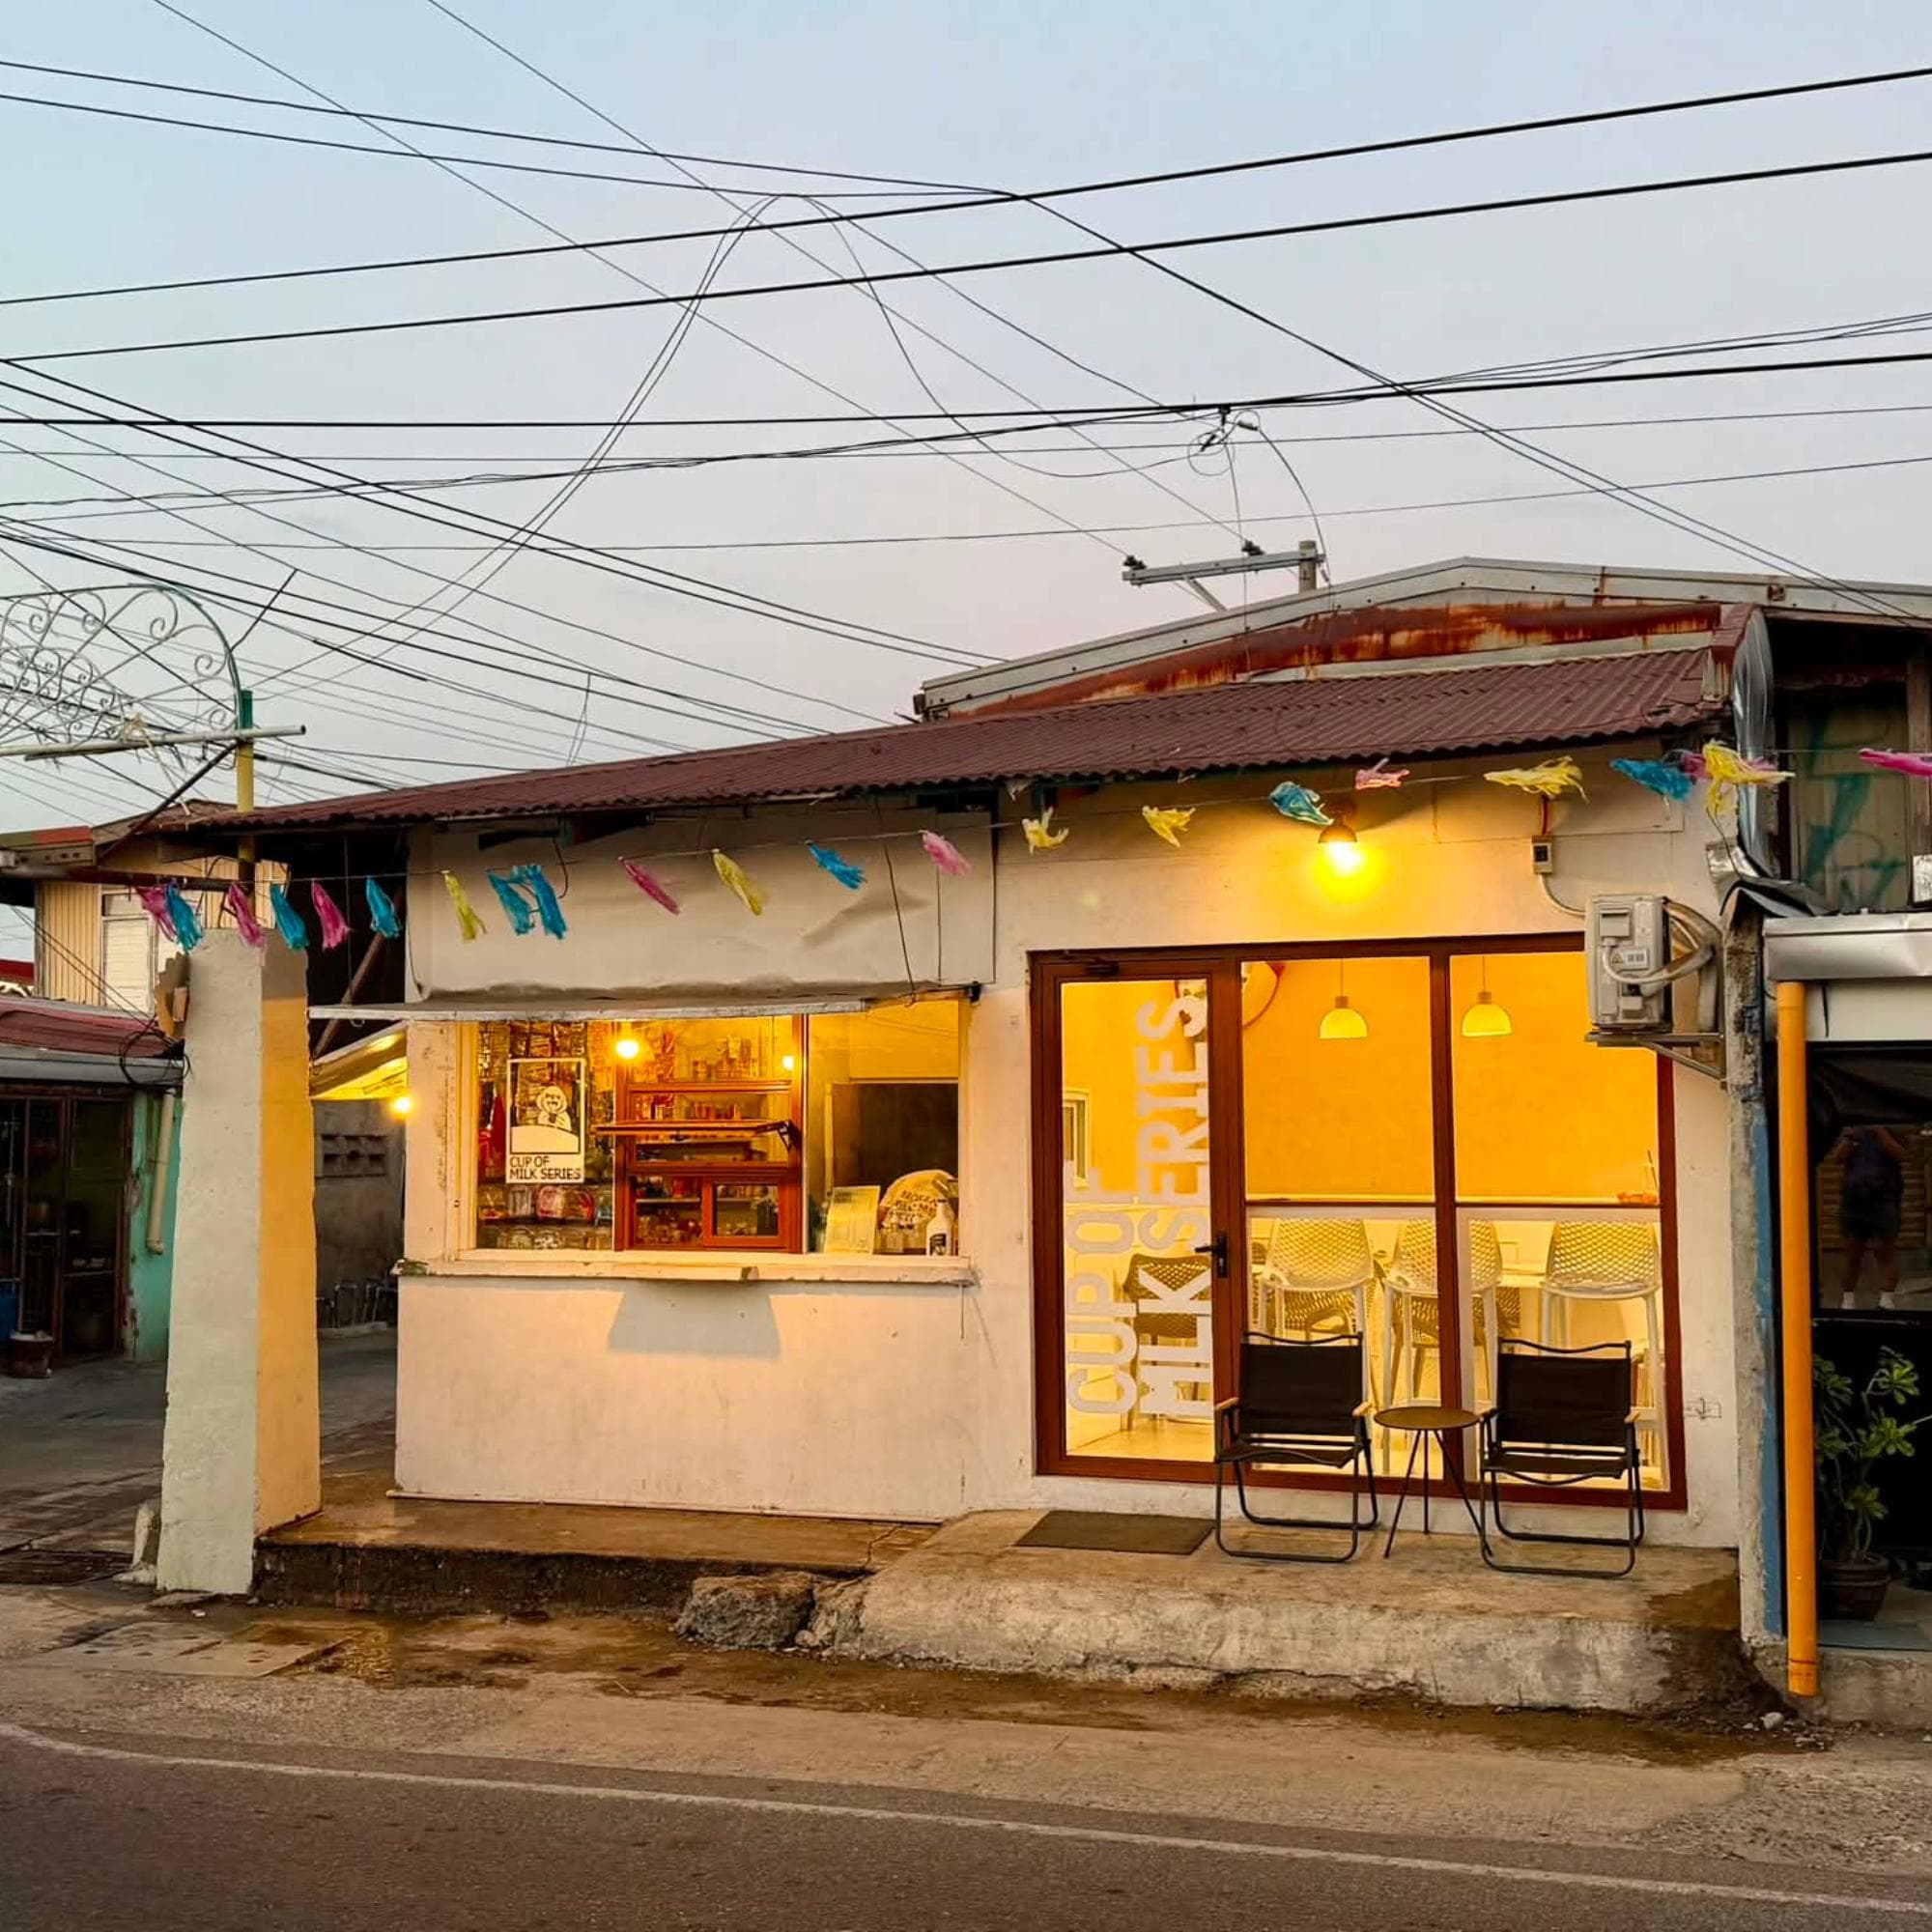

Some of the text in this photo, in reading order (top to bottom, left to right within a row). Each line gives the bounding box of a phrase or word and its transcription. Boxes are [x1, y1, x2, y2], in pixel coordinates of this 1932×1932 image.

[509, 1155, 550, 1168] CUP OF
[509, 1167, 582, 1179] MILK SERIES
[1134, 996, 1211, 1415] MILK SERIES
[1063, 1159, 1137, 1414] CUP OF
